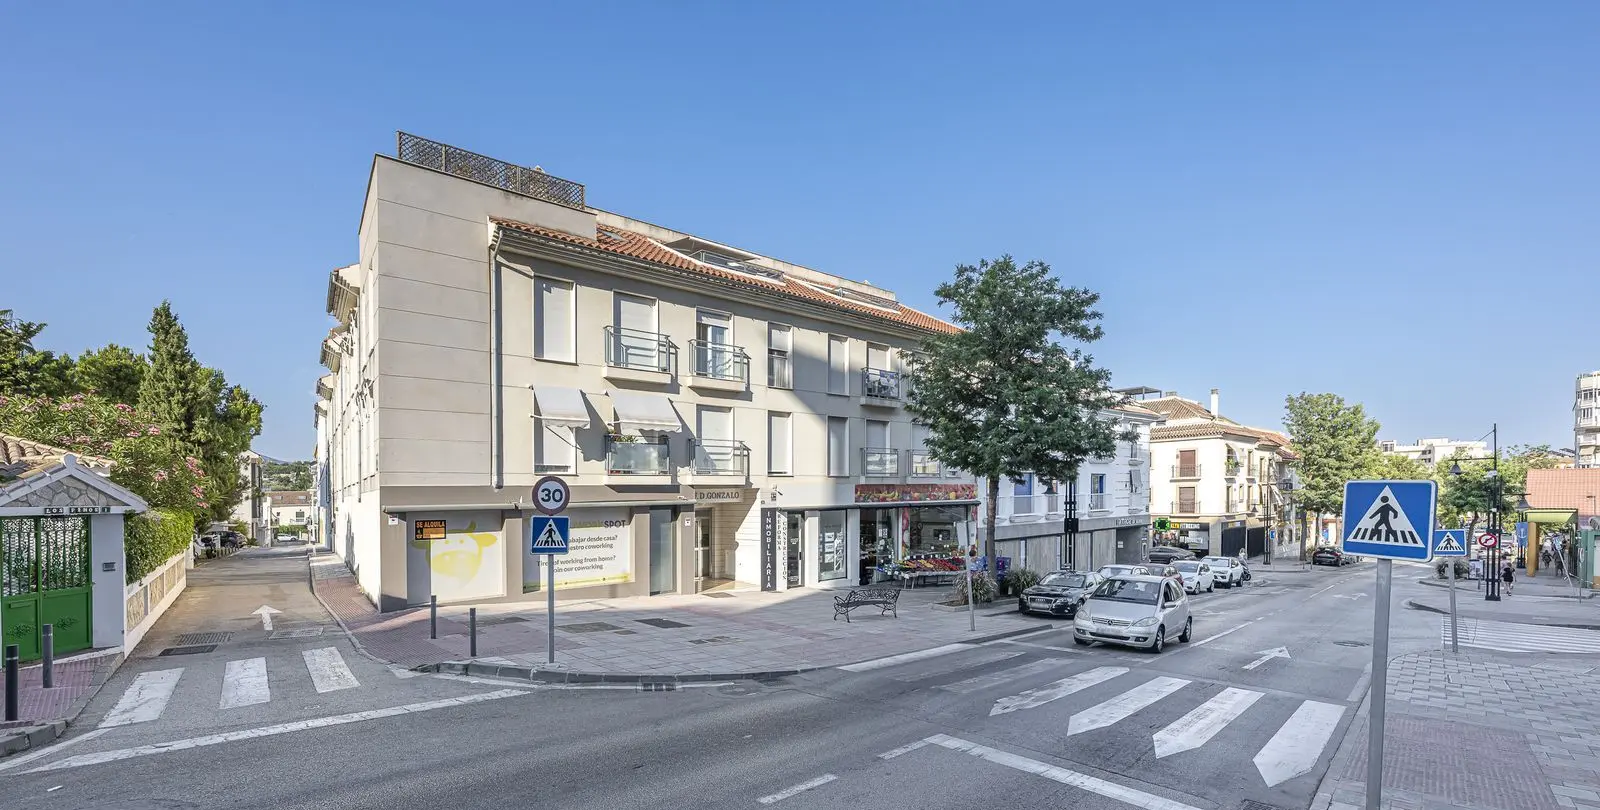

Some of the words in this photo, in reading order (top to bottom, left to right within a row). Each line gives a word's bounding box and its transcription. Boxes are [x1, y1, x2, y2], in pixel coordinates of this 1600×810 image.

[541, 488, 563, 502] 30
[586, 534, 603, 542] desde
[574, 563, 604, 571] coworking
